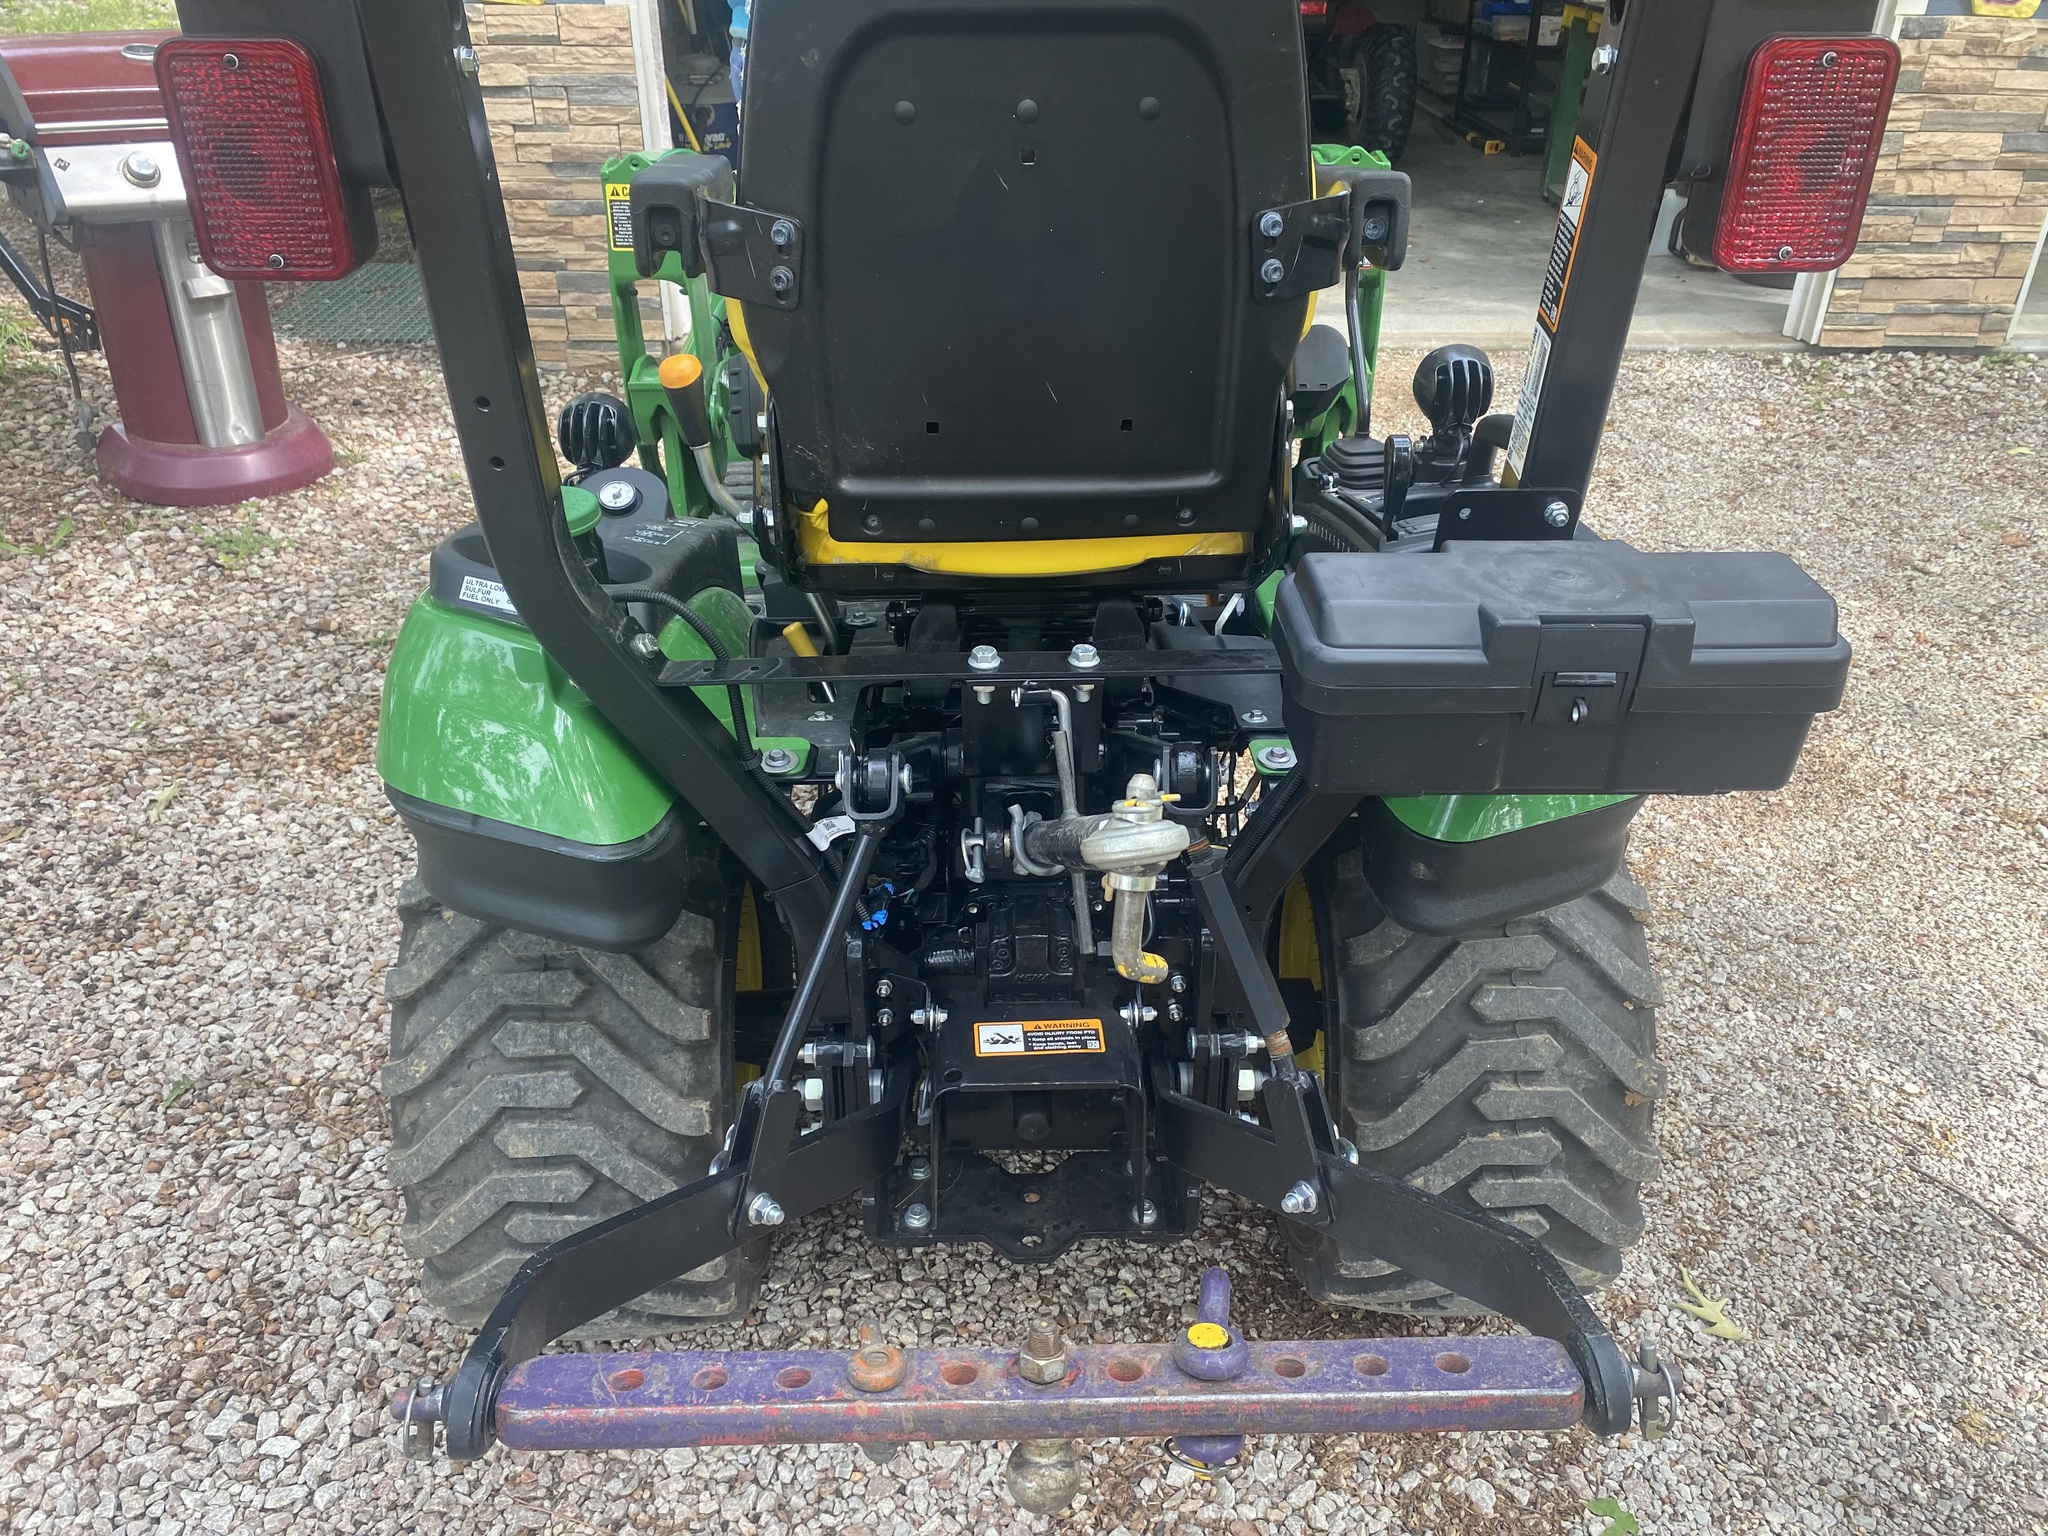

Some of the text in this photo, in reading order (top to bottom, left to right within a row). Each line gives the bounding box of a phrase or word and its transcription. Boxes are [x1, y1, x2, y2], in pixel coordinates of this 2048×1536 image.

[466, 578, 488, 588] ULTRA
[464, 585, 492, 597] SULFUR
[462, 591, 480, 601] FUEL
[480, 595, 501, 605] ONLY
